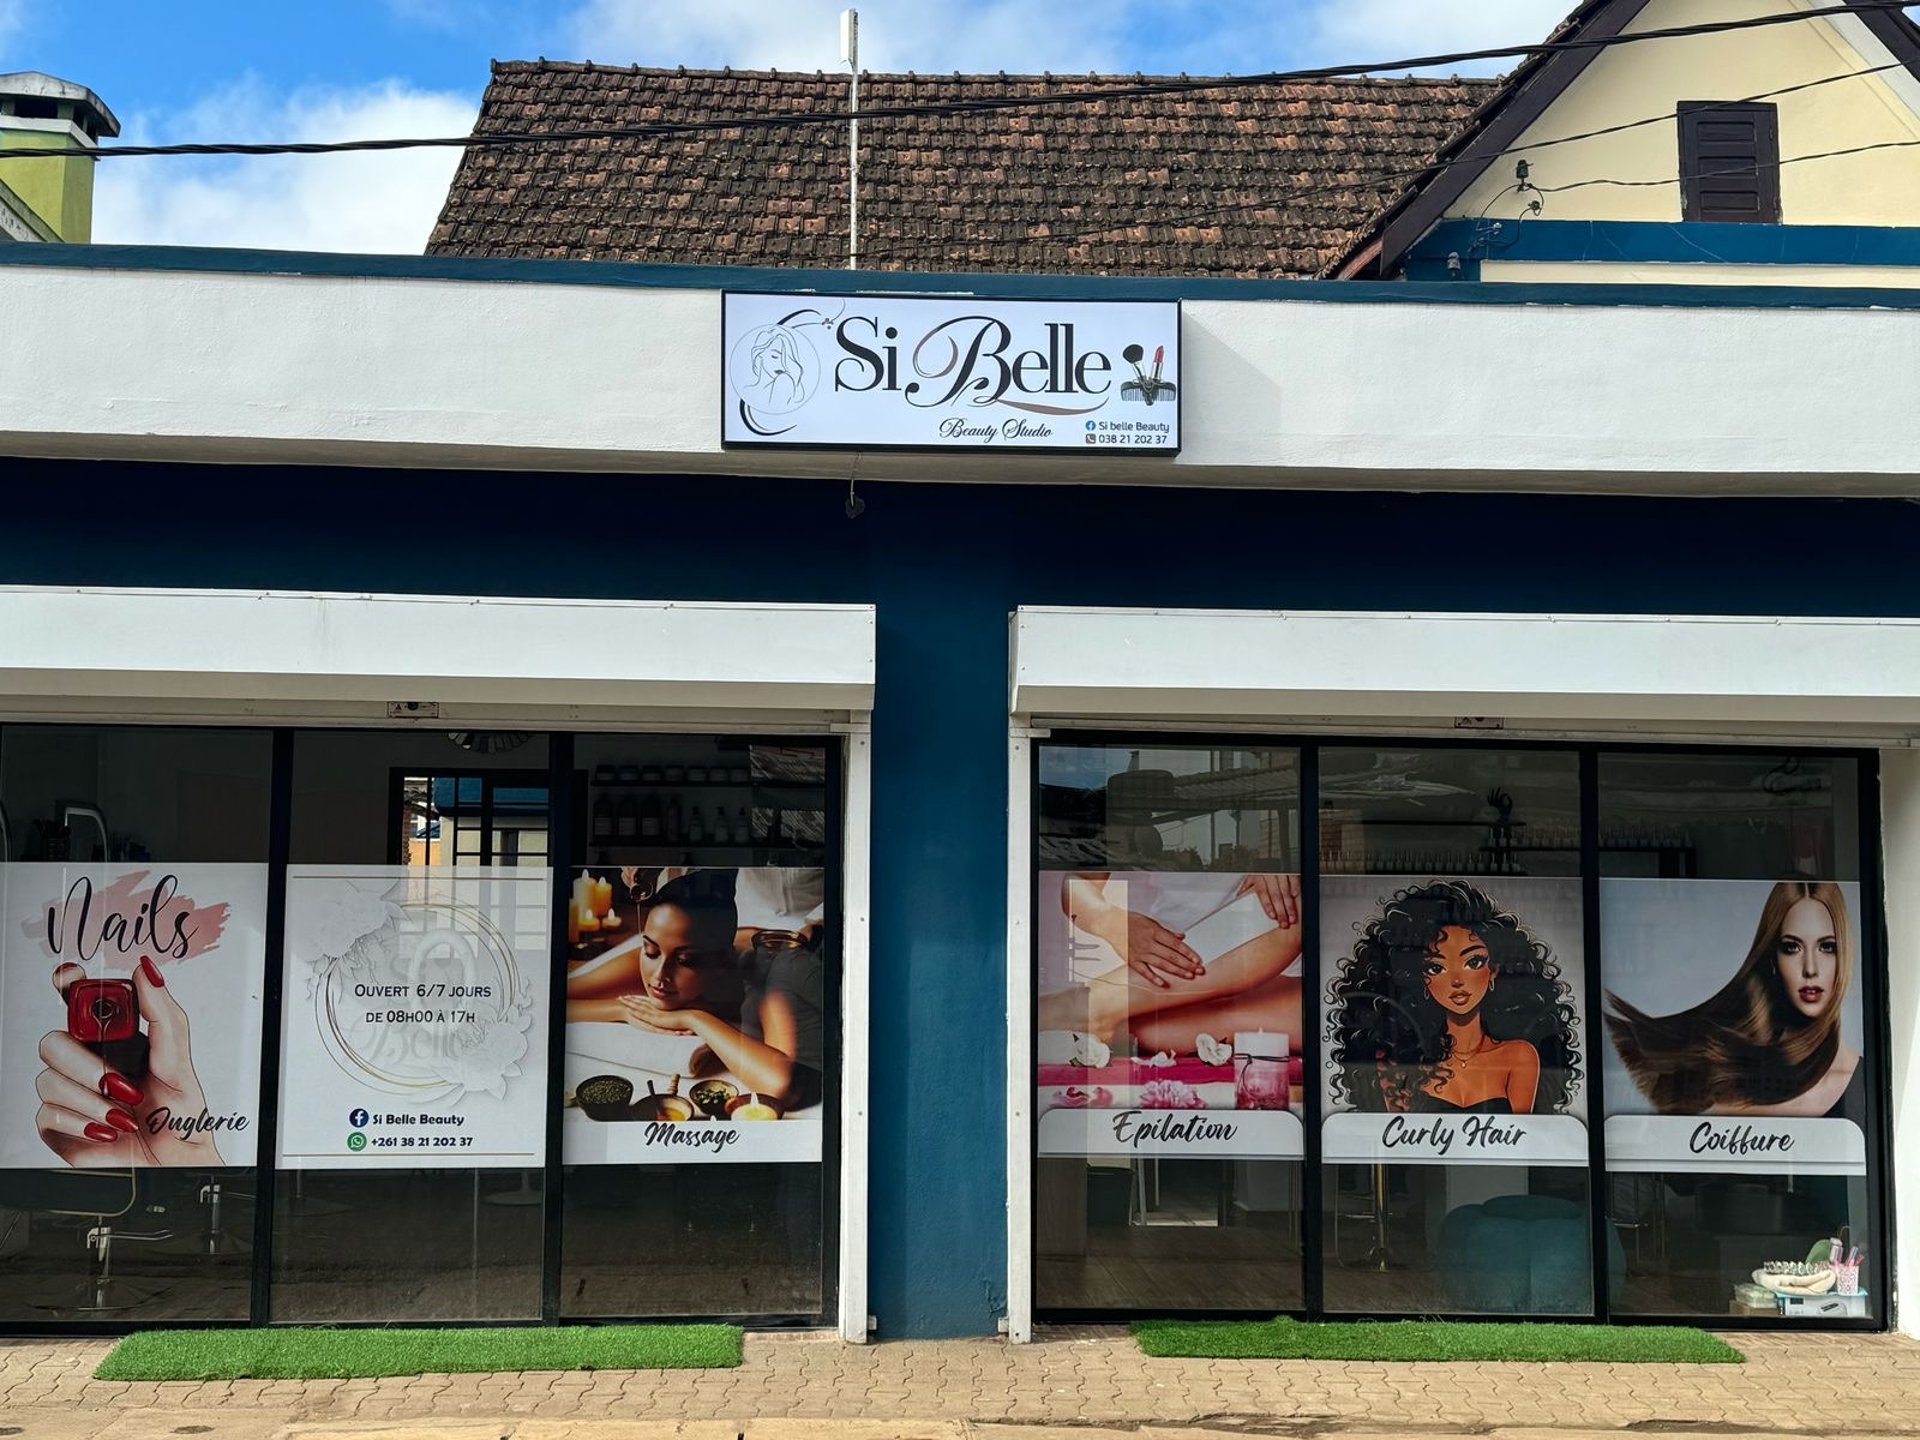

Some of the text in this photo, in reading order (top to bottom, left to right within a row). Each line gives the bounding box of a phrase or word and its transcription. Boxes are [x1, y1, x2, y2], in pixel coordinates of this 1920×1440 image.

[834, 315, 1112, 415] Si Belle
[938, 417, 1054, 443] Beauty Studio
[1098, 421, 1170, 434] Si belle Beauty
[1098, 434, 1168, 444] 038 21 202 37
[47, 874, 199, 960] Nails
[416, 983, 446, 998] 6/7
[436, 1008, 446, 1023] À
[145, 1106, 250, 1141] Onglerie
[372, 1113, 465, 1127] Si Belle Beauty
[1111, 1110, 1239, 1149] Epilation
[371, 1136, 474, 1148] +261 38 21 202 37
[643, 1121, 741, 1154] Massage
[1381, 1115, 1528, 1156] Curly Hair
[1688, 1121, 1796, 1156] Coiffure
